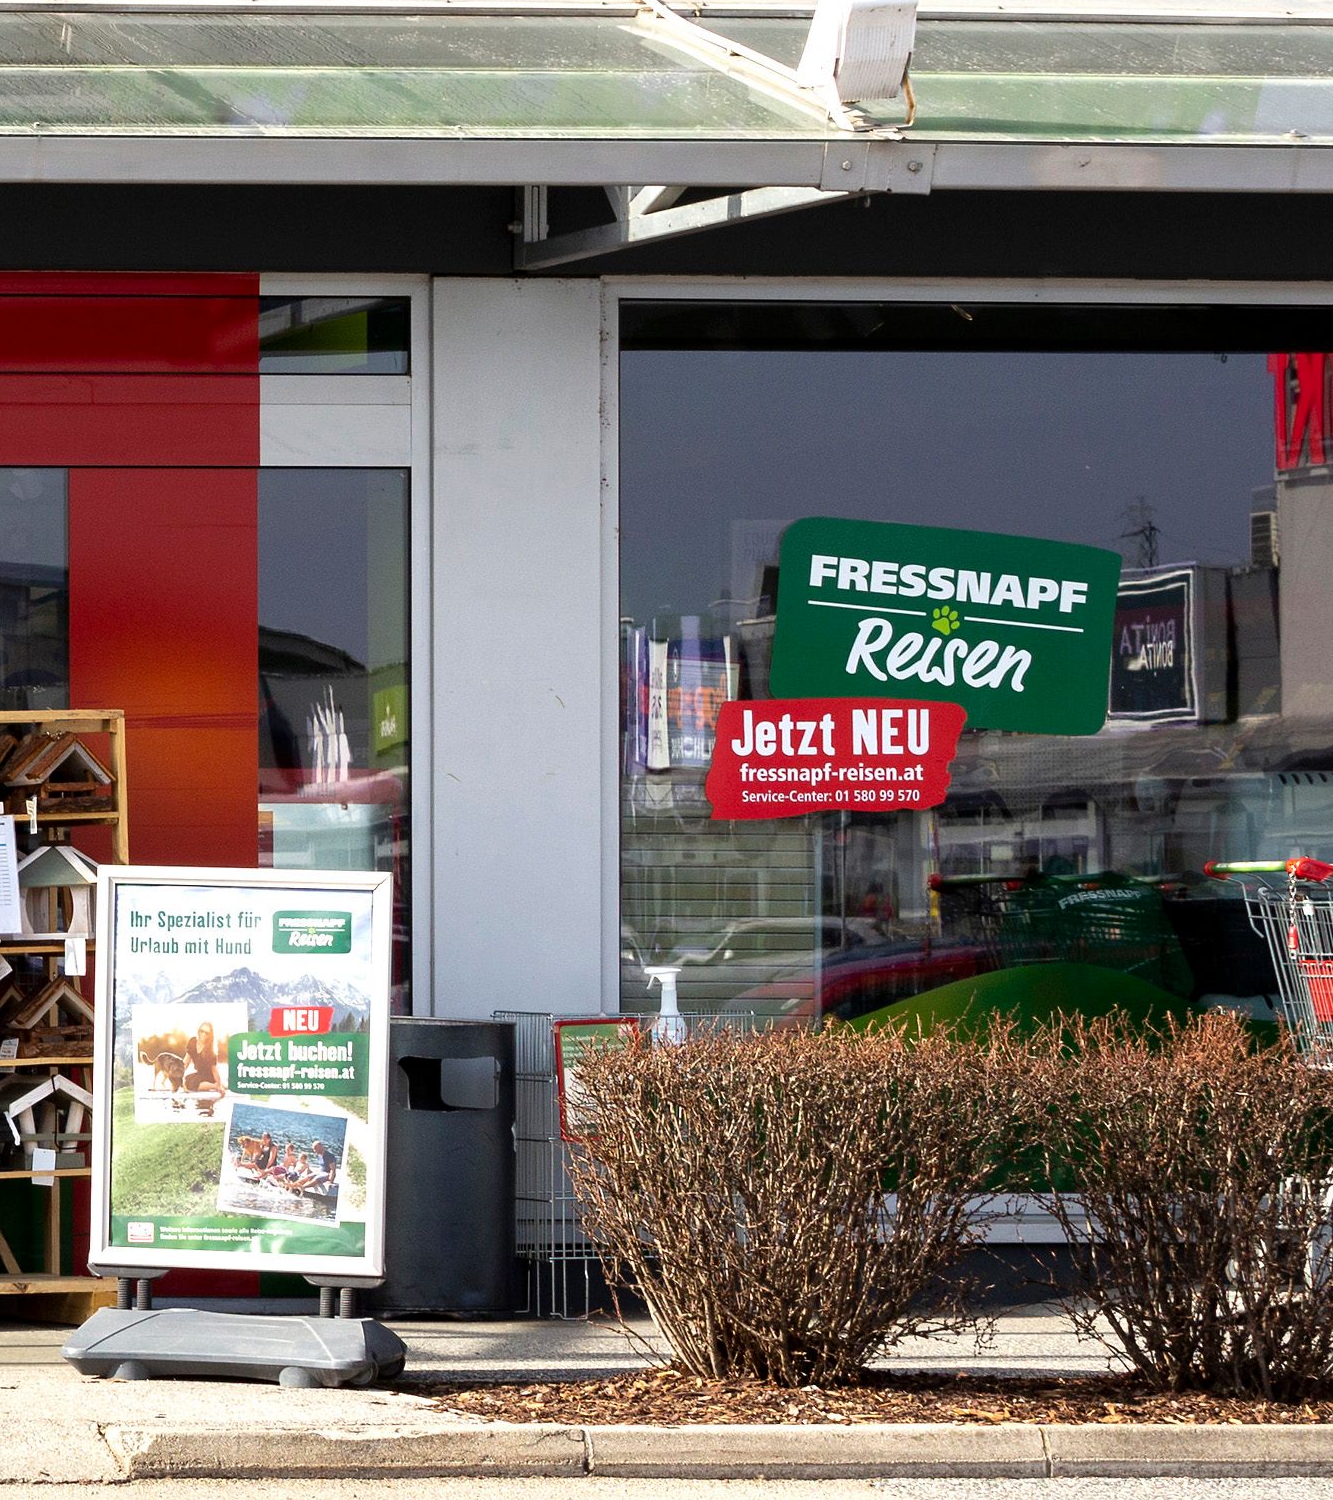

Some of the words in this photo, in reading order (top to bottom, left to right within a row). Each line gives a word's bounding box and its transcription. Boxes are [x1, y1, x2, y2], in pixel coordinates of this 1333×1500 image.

[808, 554, 1088, 613] FRESSNAPF
[845, 617, 1032, 693] Reisen
[731, 709, 836, 757] Jetzt
[851, 708, 930, 756] NEU
[740, 762, 924, 786] fressnapf-reisen.at
[741, 789, 833, 803] Service-Center:
[835, 789, 849, 802] 01
[853, 789, 877, 802] 580
[879, 789, 895, 802] 99
[897, 789, 921, 802] 570
[130, 910, 152, 928] Ihr
[157, 910, 231, 932] Spezialist
[238, 911, 262, 929] für
[130, 937, 179, 954] Urlaub
[184, 937, 209, 954] mit
[216, 938, 251, 955] Hund
[288, 931, 334, 947] Reisen
[282, 1009, 319, 1032] NEU
[237, 1040, 282, 1062] Jetzt
[288, 1040, 353, 1062] buchen!
[237, 1064, 355, 1082] fressnapf-reisen.at
